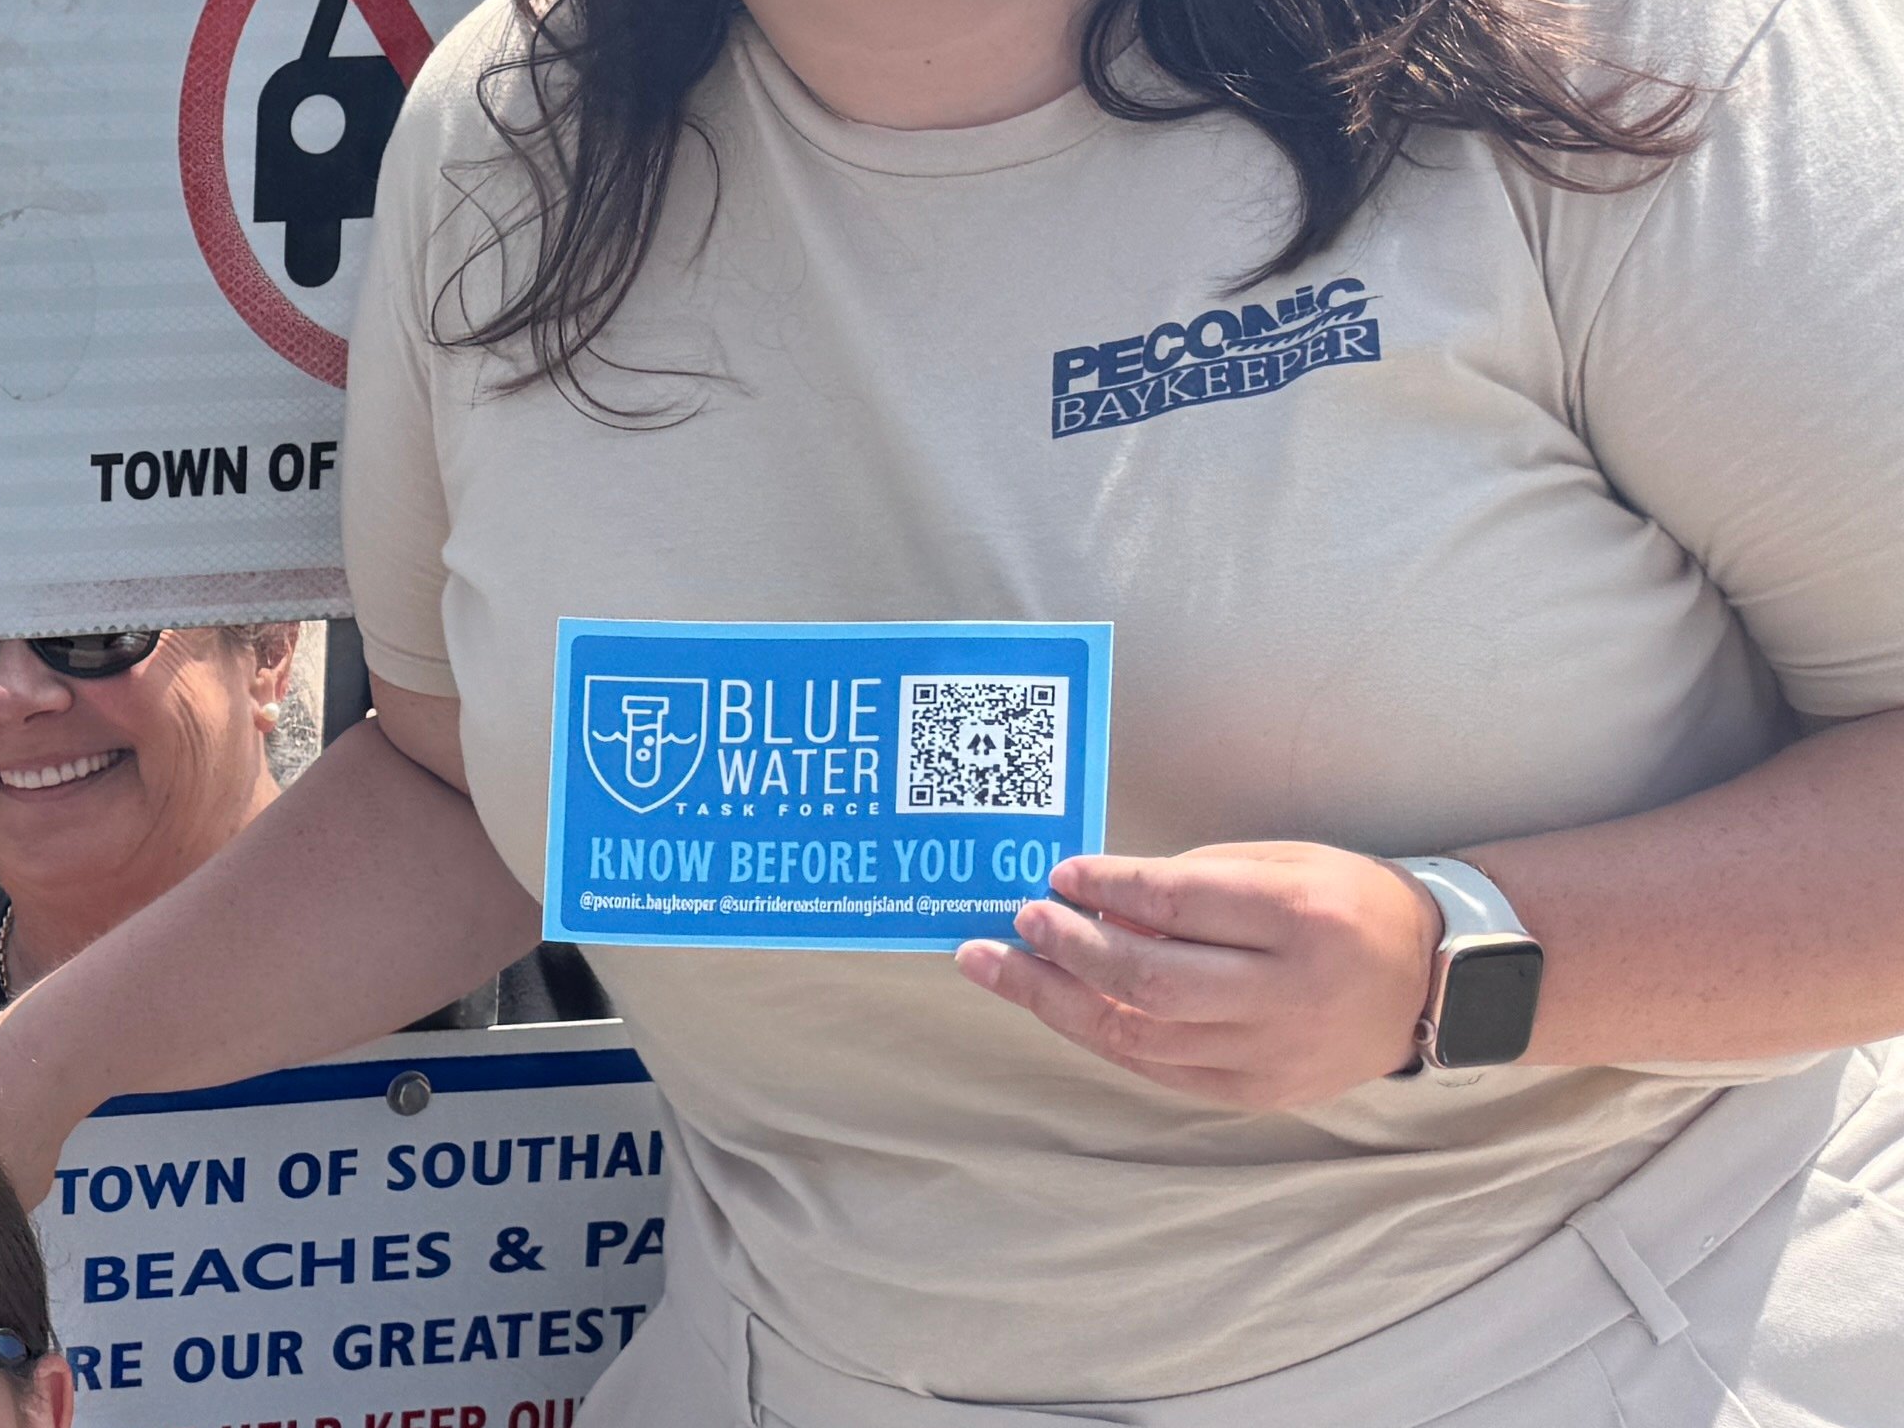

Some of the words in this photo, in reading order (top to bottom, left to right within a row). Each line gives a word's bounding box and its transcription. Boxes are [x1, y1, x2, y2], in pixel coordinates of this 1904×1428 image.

[1056, 323, 1376, 435] BAYKEEPER
[91, 446, 247, 501] TOWN
[268, 440, 337, 492] OF
[720, 679, 881, 743] BLUE
[718, 748, 878, 795] WATER
[676, 803, 753, 816] TASK
[779, 802, 879, 816] FORCE
[591, 836, 715, 880] KNOW
[730, 838, 878, 884] BEFORE
[894, 838, 974, 884] YOU
[992, 838, 1061, 883] GO!
[54, 1157, 246, 1216] TOWN
[279, 1149, 357, 1198] OF
[84, 1232, 451, 1303] BEACHES
[490, 1227, 545, 1273] &
[174, 1331, 303, 1383] OUR
[333, 1305, 646, 1371] GREATEST
